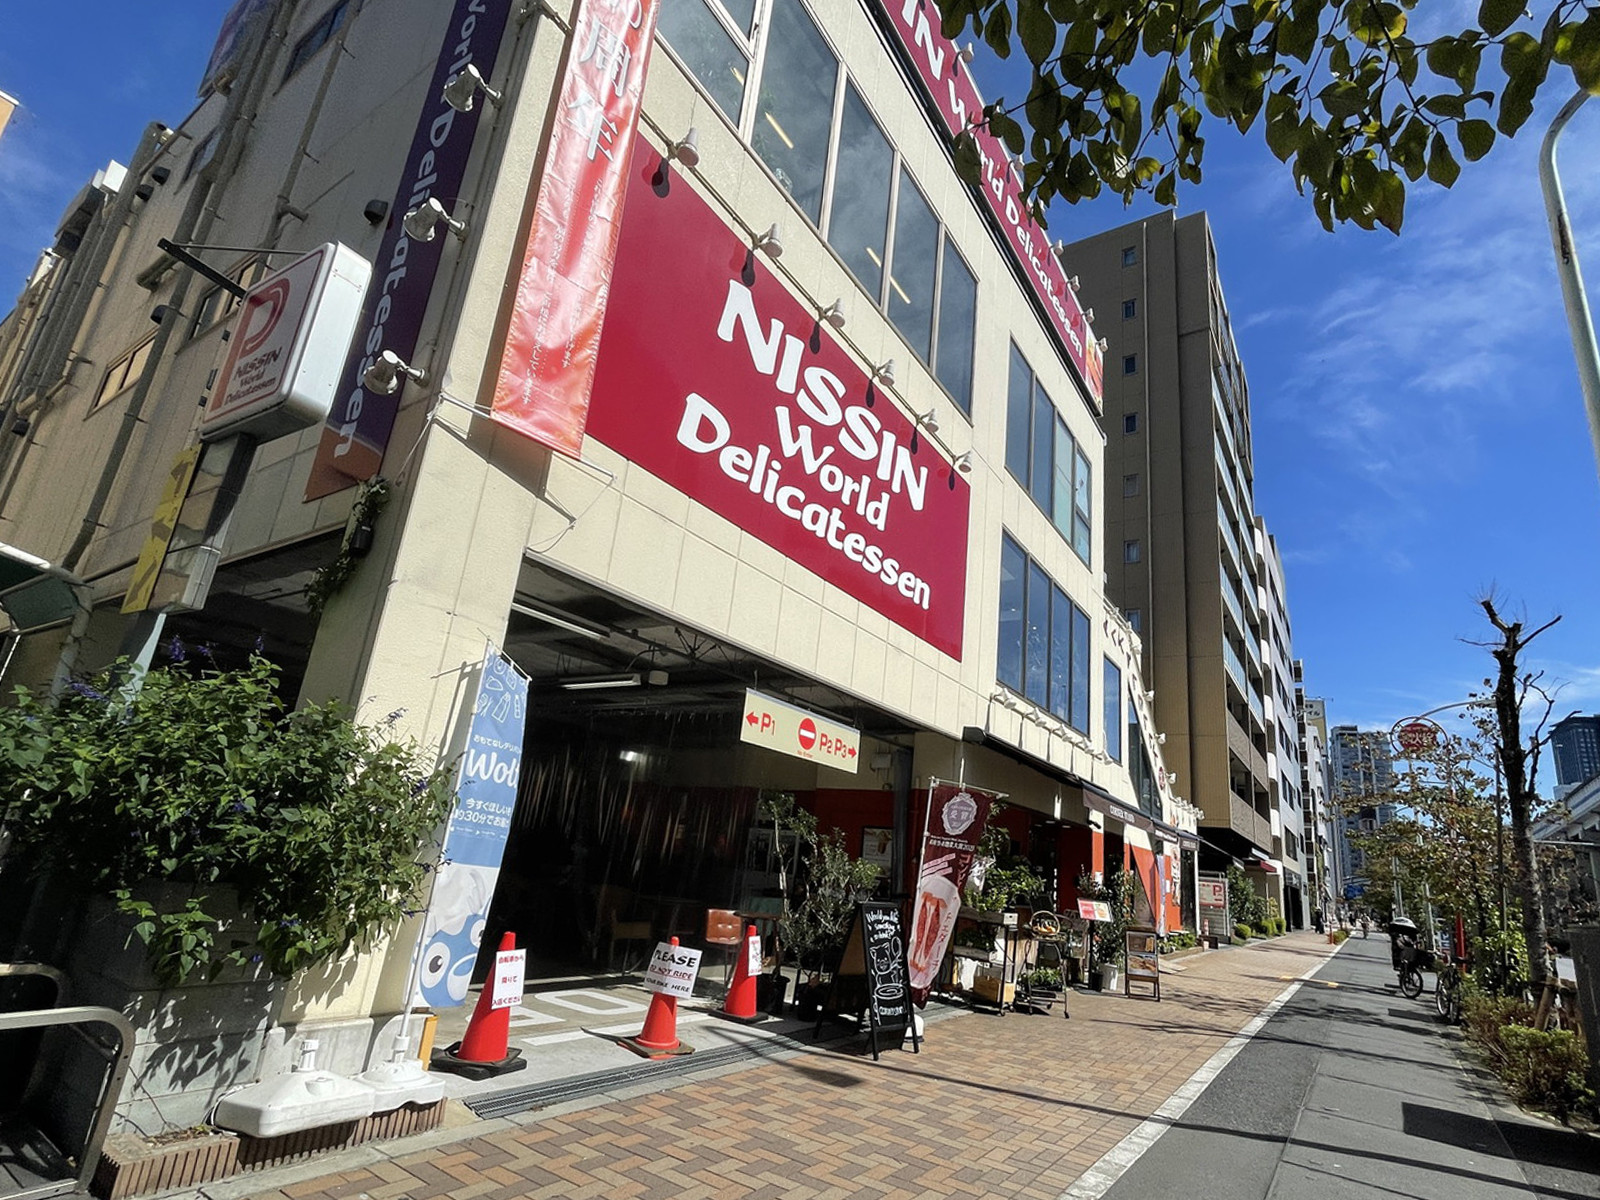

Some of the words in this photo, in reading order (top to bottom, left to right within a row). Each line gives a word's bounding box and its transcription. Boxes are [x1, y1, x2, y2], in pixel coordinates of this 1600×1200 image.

[947, 78, 1005, 202] Wrld
[1005, 194, 1083, 359] Delicatessen
[334, 108, 456, 458] Deliatessen
[211, 278, 291, 413] P
[233, 347, 283, 381] NISSIN
[225, 376, 277, 405] Delicatessen
[717, 279, 929, 512] NISSIN
[776, 405, 890, 532] World
[676, 392, 931, 611] Delicatessen
[760, 712, 776, 736] P1
[819, 732, 833, 754] P2
[834, 738, 847, 758] P3
[1212, 884, 1223, 897] P
[653, 949, 697, 968] PLEASE
[671, 984, 690, 993] HERE
[673, 970, 693, 979] RIDE
